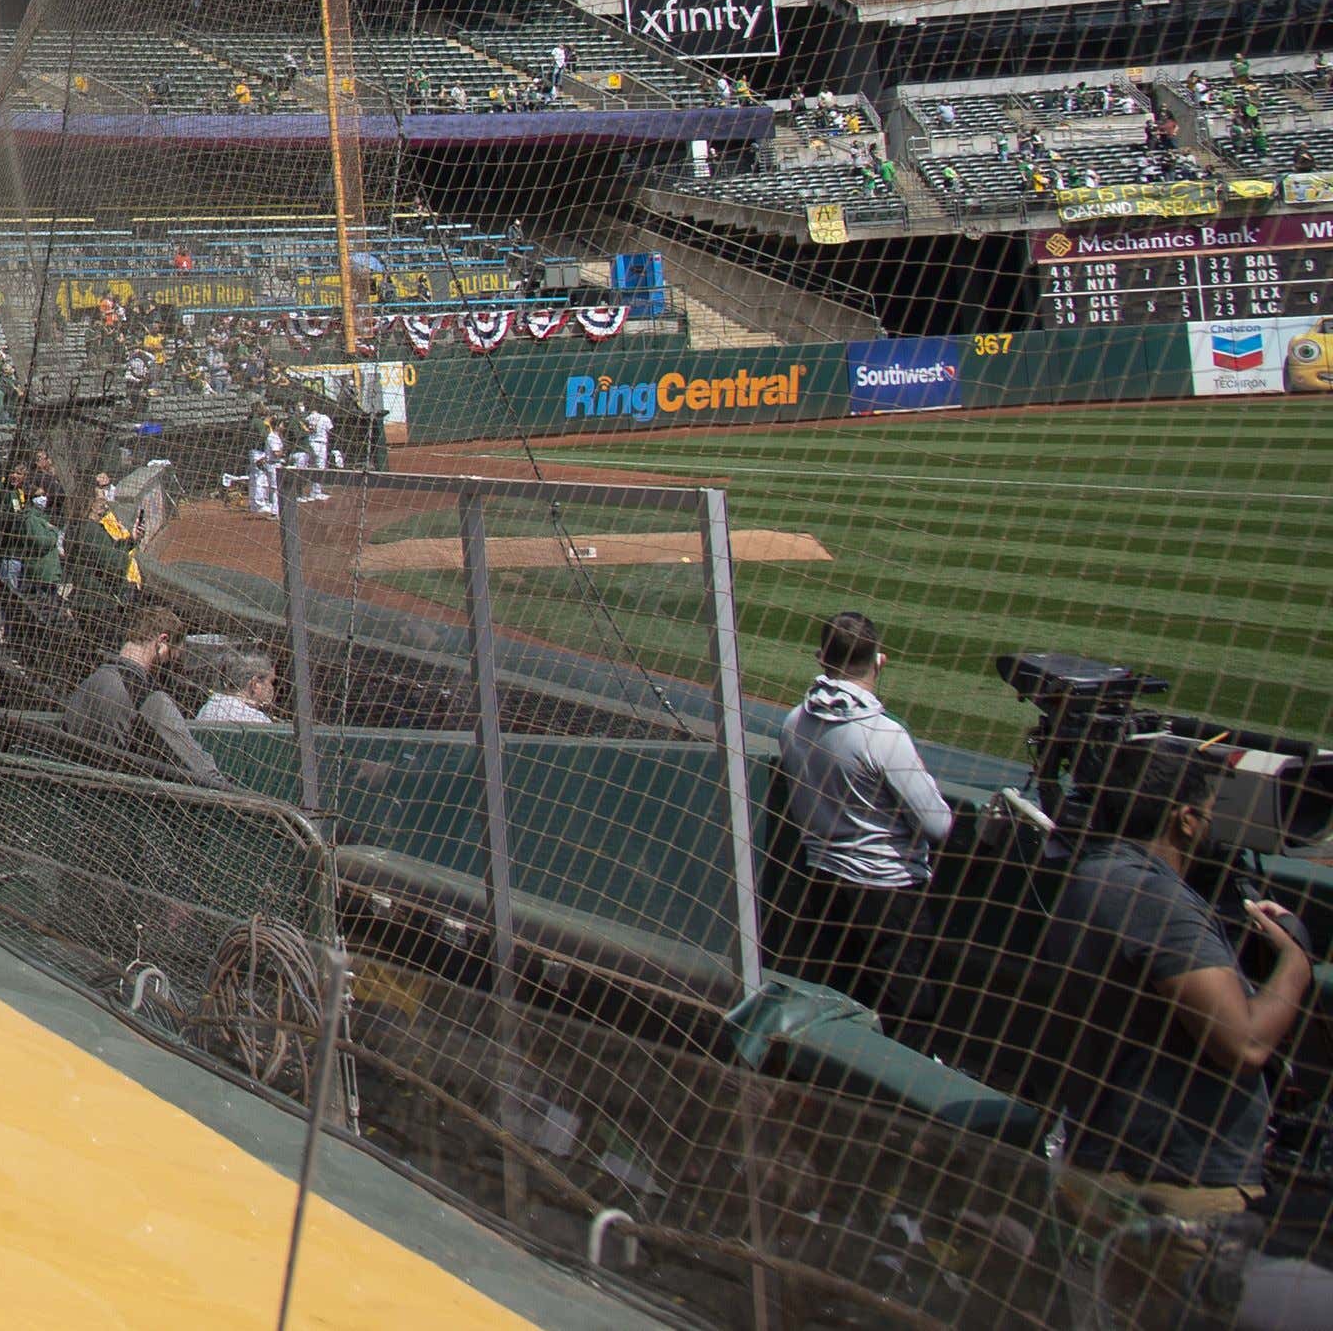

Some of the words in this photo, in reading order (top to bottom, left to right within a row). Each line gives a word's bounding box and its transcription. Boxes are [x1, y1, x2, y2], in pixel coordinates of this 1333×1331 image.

[1060, 182, 1209, 205] RESPECT
[1064, 201, 1132, 220] OAKLAND
[1136, 199, 1221, 218] BASEBALL
[1077, 232, 1195, 253] Mechanics
[1201, 225, 1257, 246] Bank
[1085, 263, 1117, 276] TOR
[1177, 260, 1186, 271] 3
[1245, 254, 1277, 267] BAL
[1305, 260, 1314, 271] 9
[1086, 278, 1117, 291] NYY
[1178, 274, 1187, 285] 5
[1245, 269, 1278, 282] BOS
[1089, 295, 1120, 308] CLE
[1250, 286, 1281, 300] TEX
[1309, 292, 1318, 303] 6
[1089, 309, 1121, 322] DET
[1182, 305, 1190, 317] 5
[1210, 325, 1262, 334] Chevron
[974, 333, 1013, 355] 367
[856, 363, 944, 386] Southwest
[565, 365, 800, 422] RingCentral
